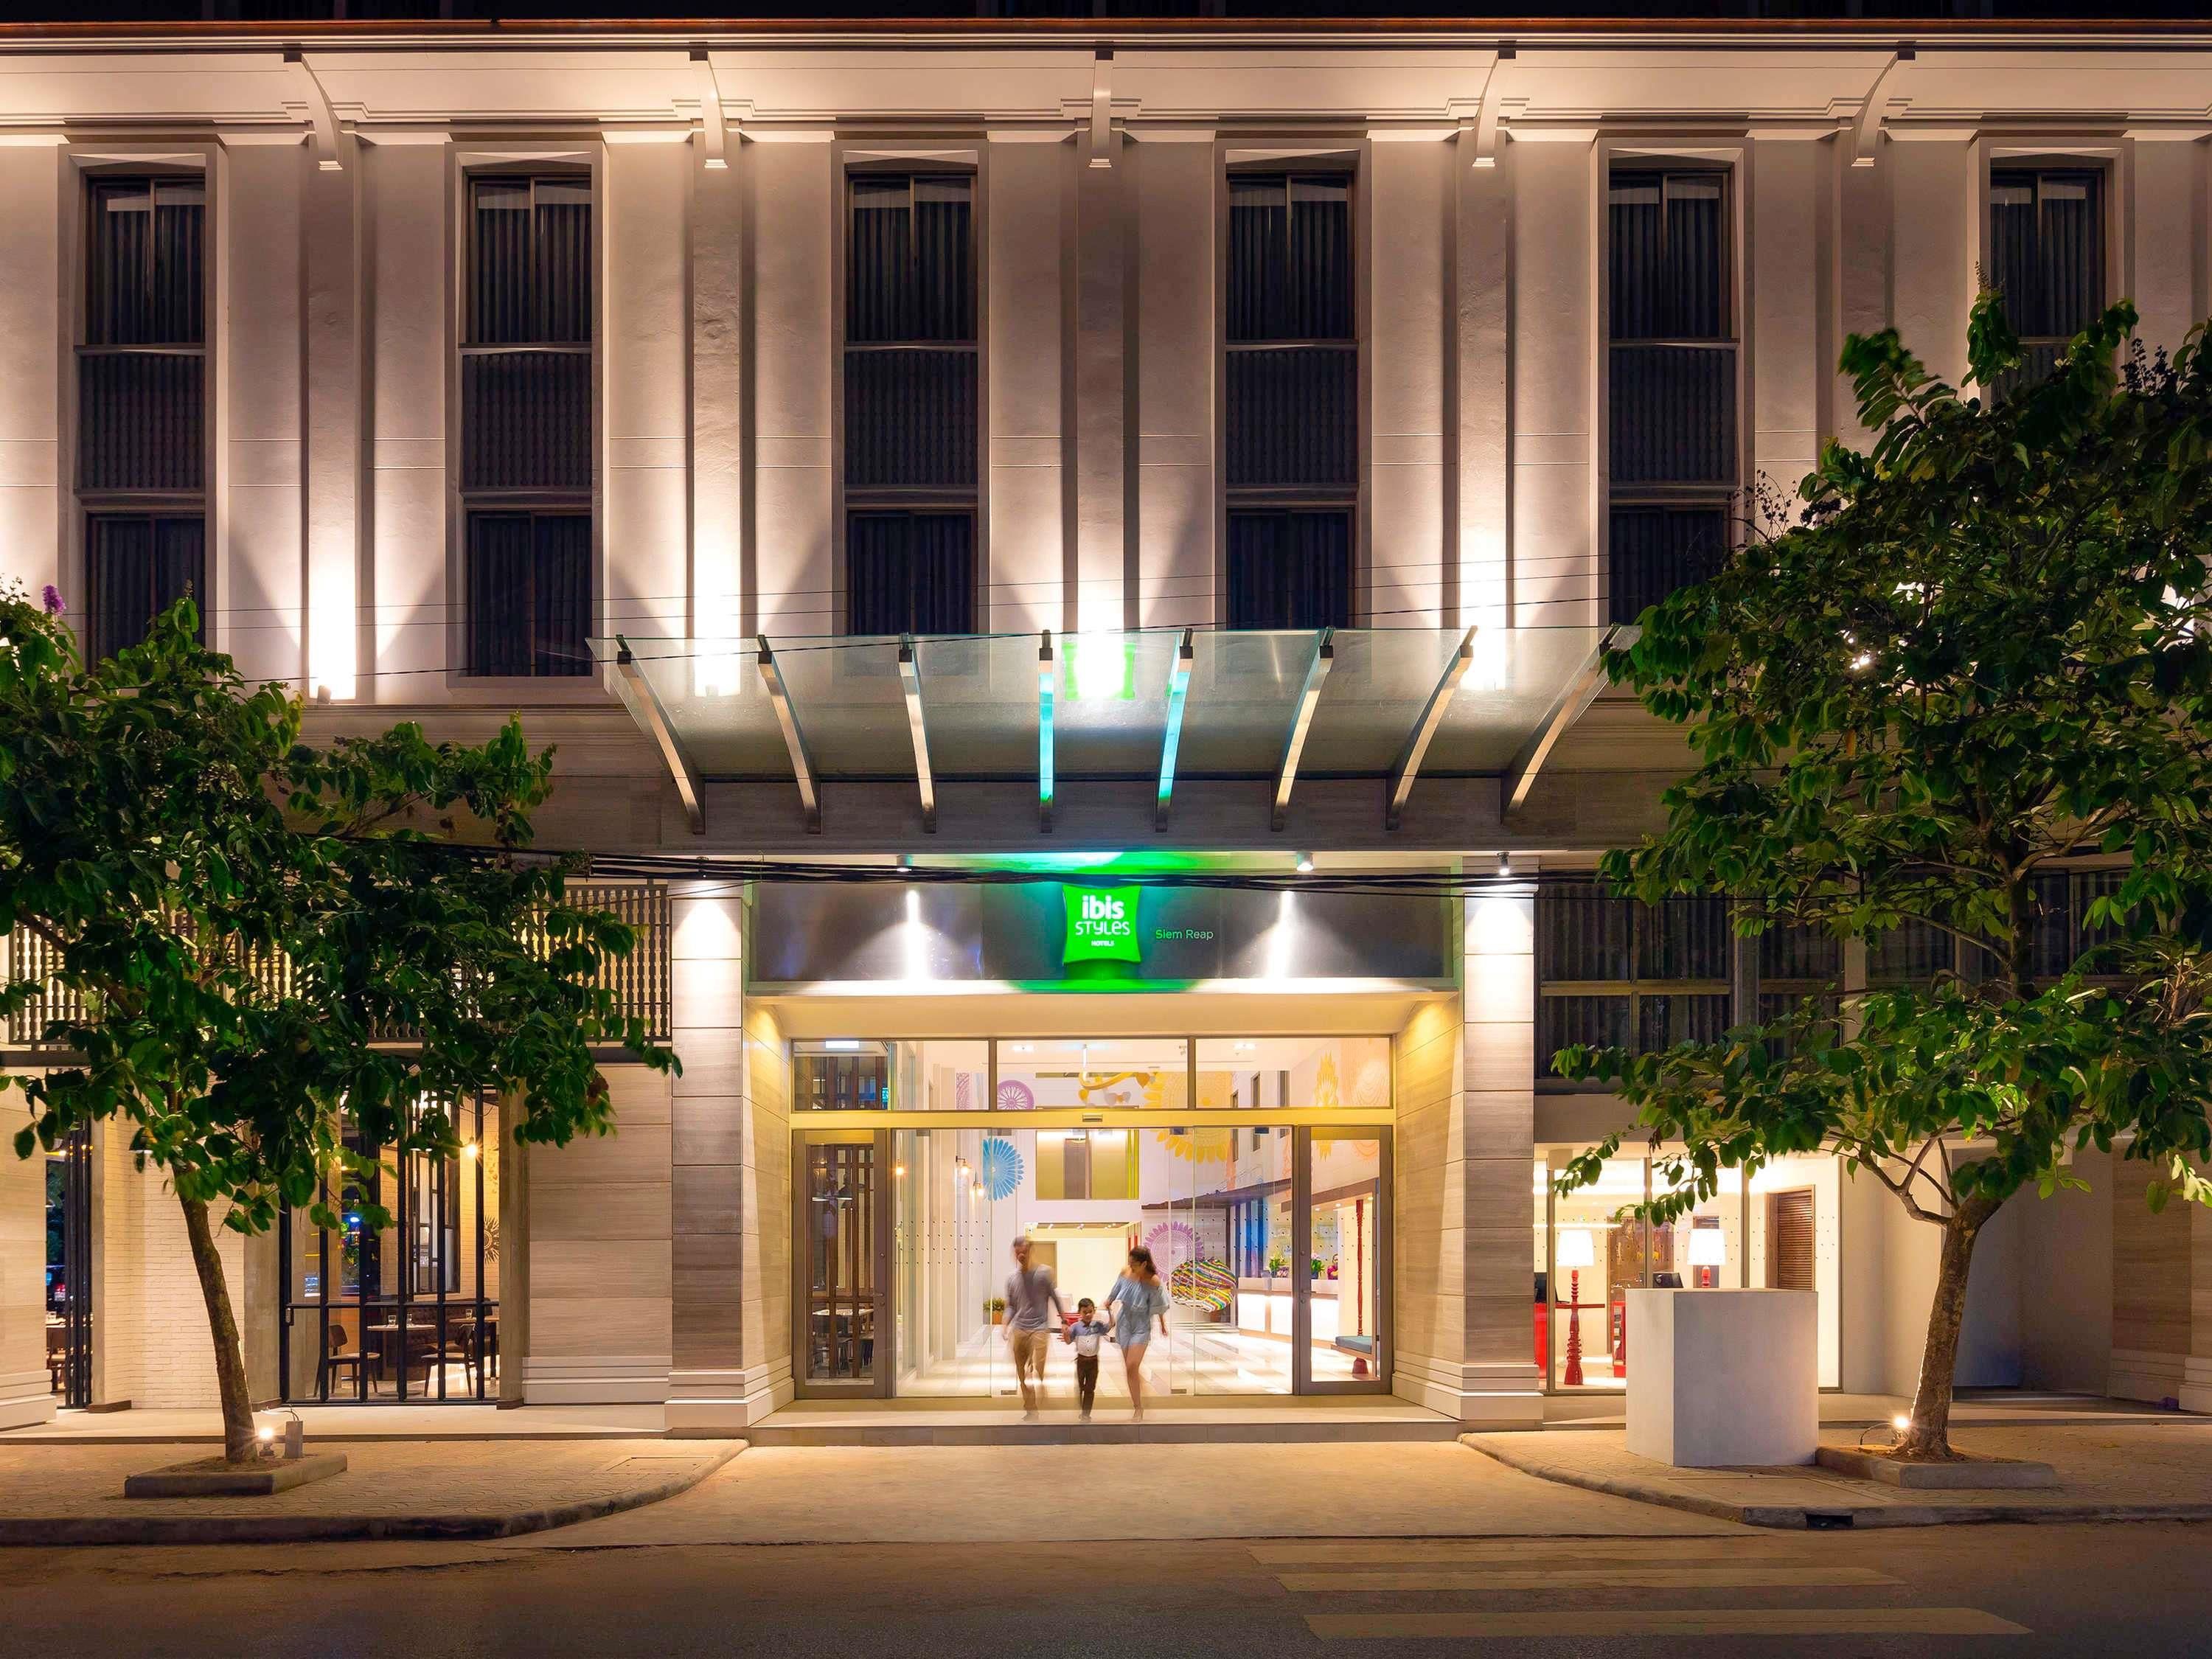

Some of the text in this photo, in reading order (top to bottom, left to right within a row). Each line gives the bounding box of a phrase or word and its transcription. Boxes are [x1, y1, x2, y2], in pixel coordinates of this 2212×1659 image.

[1082, 894, 1125, 920] ibis
[1155, 929, 1214, 941] Siem Reap
